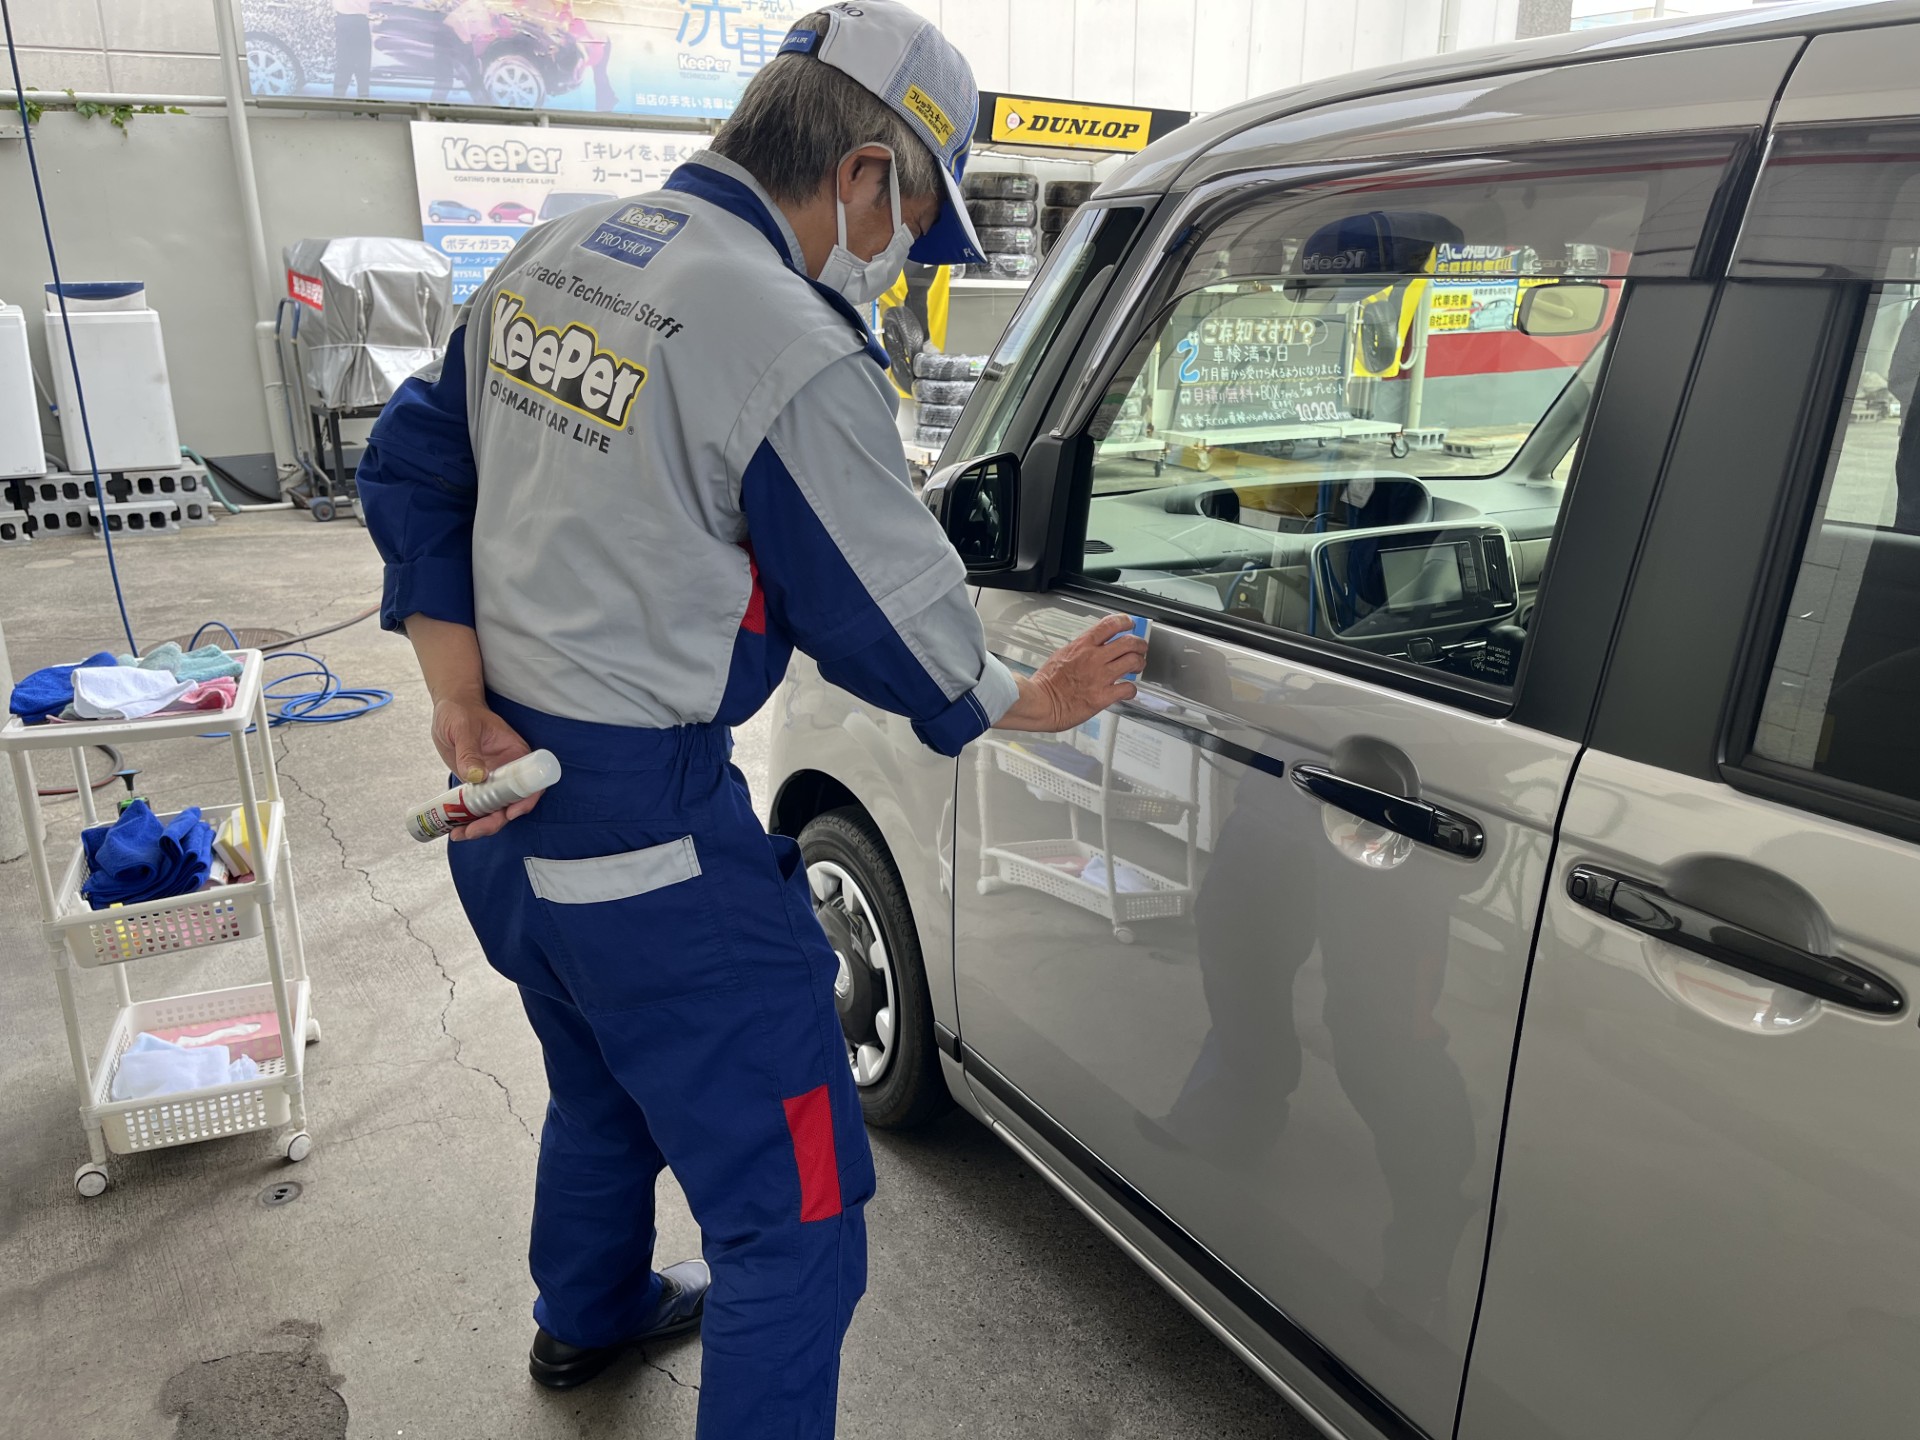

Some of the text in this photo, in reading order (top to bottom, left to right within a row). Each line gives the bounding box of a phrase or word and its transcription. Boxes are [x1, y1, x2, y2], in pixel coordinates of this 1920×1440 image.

[678, 53, 730, 73] KeePer
[1027, 114, 1140, 139] DUNLOP
[442, 137, 562, 174] KeePer
[453, 175, 485, 183] COATING
[618, 207, 678, 235] KeePer
[446, 238, 511, 250] ボディガラス
[595, 231, 652, 257] PRO SHOP
[453, 271, 482, 279] RYSTAL
[526, 261, 684, 340] Grade Technical Staff
[1203, 318, 1316, 344] ご存知ですか?
[490, 291, 647, 427] KeePer
[1213, 344, 1288, 364] 車検満了日
[501, 389, 546, 421] SMART
[572, 423, 612, 454] LIFE
